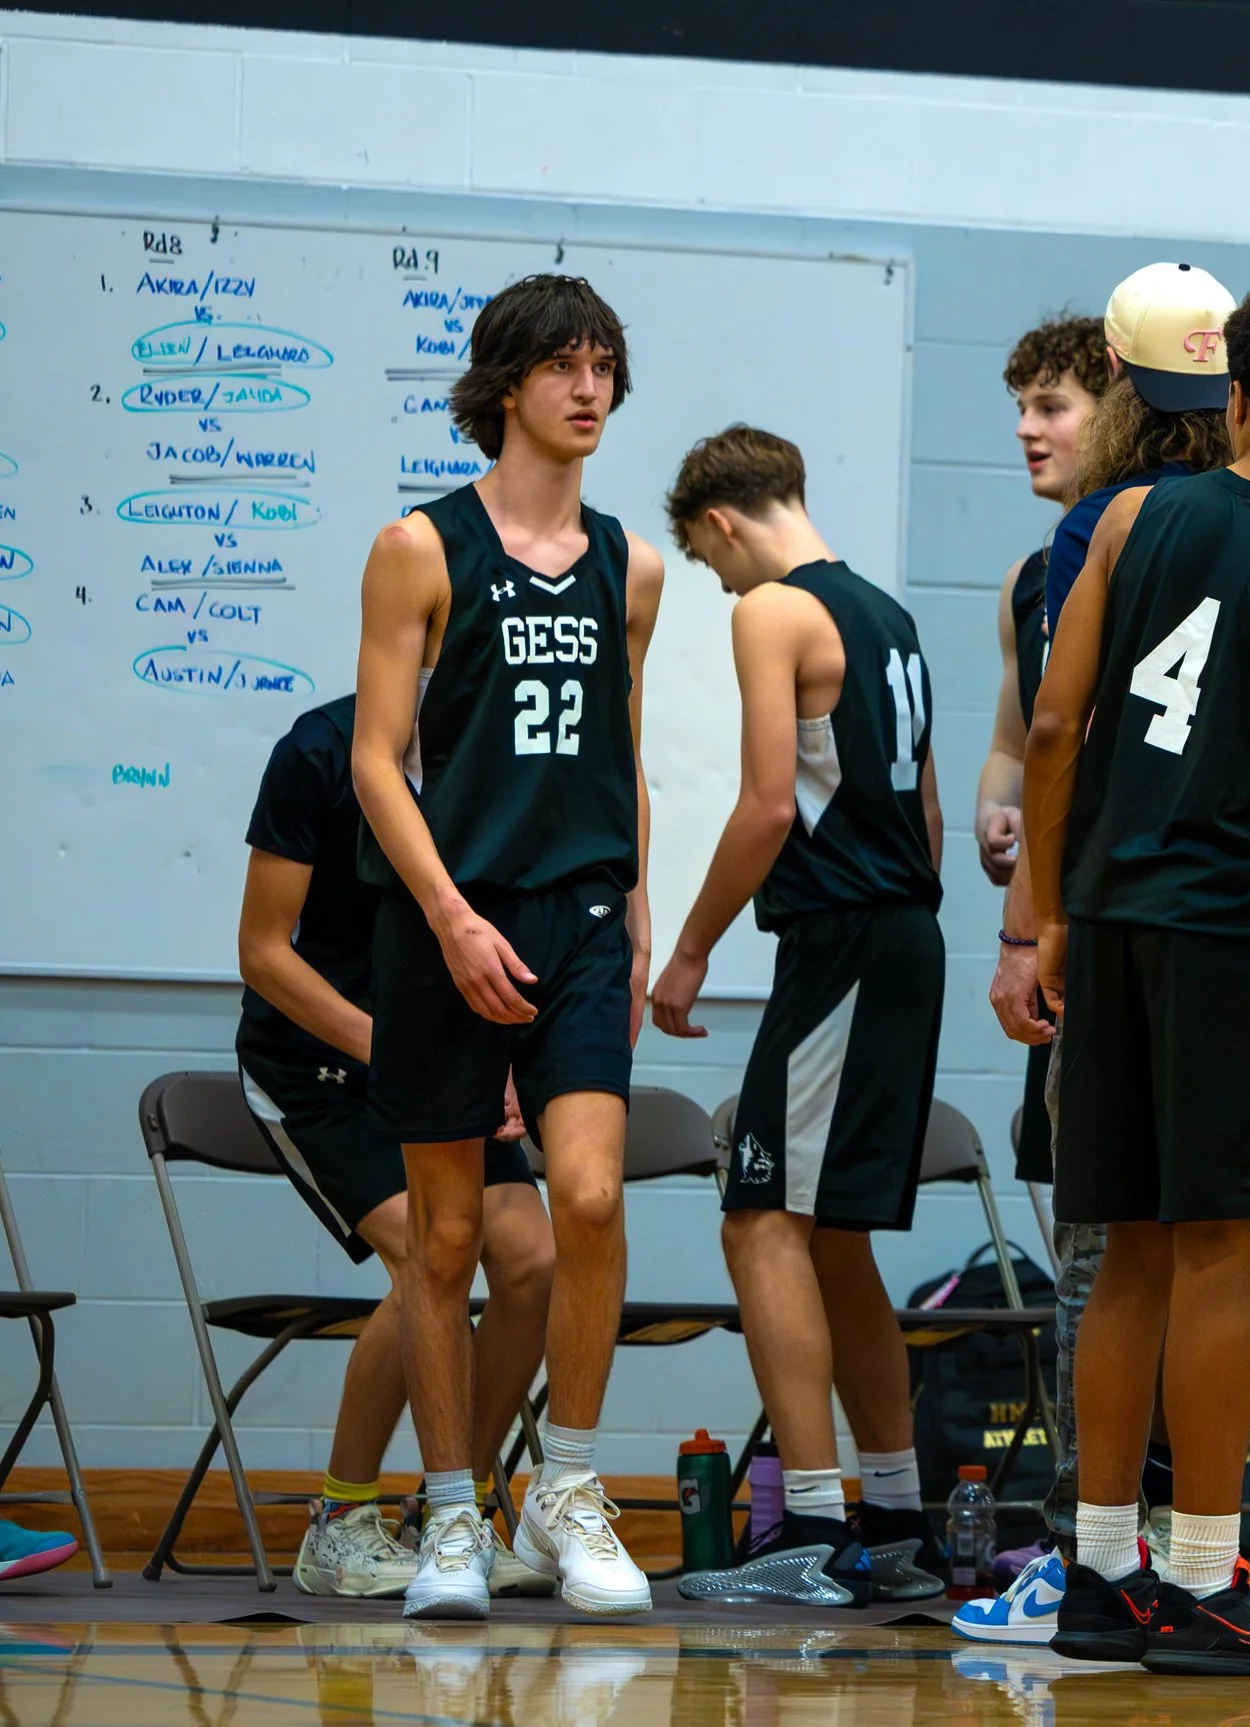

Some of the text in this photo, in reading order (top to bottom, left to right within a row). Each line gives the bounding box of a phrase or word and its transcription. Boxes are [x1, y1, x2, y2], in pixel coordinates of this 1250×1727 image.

[100, 273, 113, 293] 1.
[1183, 327, 1223, 362] F
[90, 384, 111, 405] 2.
[198, 417, 222, 433] VS
[214, 533, 238, 548] VS
[75, 585, 92, 606] 4.
[187, 629, 209, 644] VS
[501, 615, 598, 666] GESS
[1129, 596, 1222, 756] 4
[514, 679, 583, 756] 22
